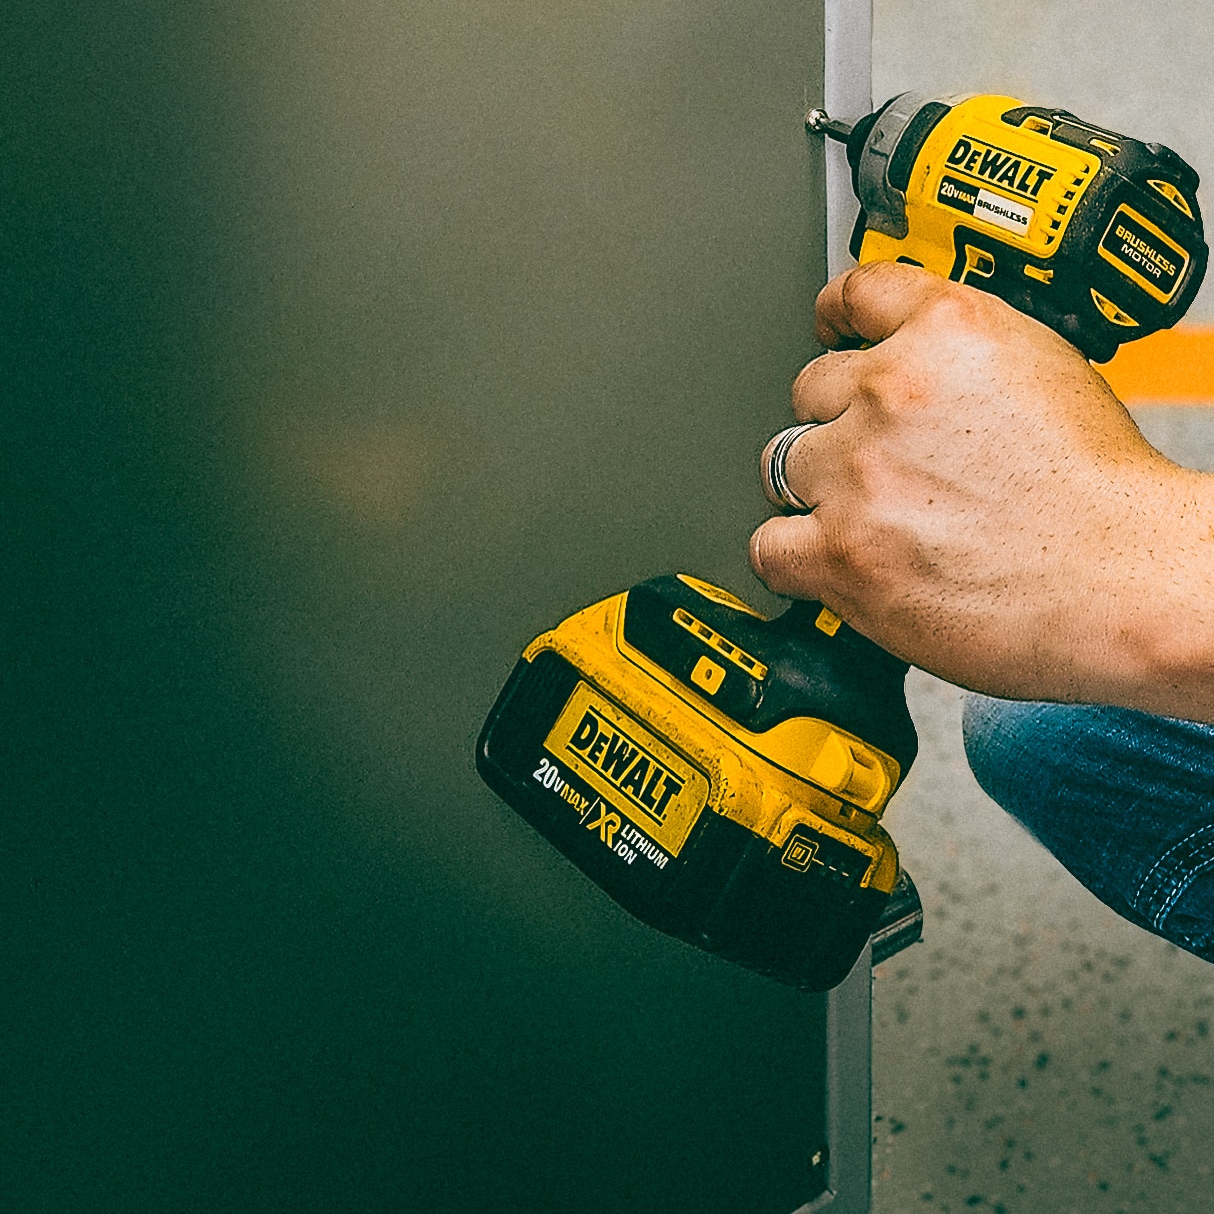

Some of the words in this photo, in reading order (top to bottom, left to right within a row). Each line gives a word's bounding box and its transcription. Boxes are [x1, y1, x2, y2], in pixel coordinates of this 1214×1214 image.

[977, 198, 1029, 226] BRUSHLESS
[1115, 224, 1177, 276] BRUSHLESS
[1120, 243, 1162, 279] MOTOR
[587, 801, 622, 848] XR
[620, 825, 669, 870] LITHIUM
[613, 841, 638, 865] ION
